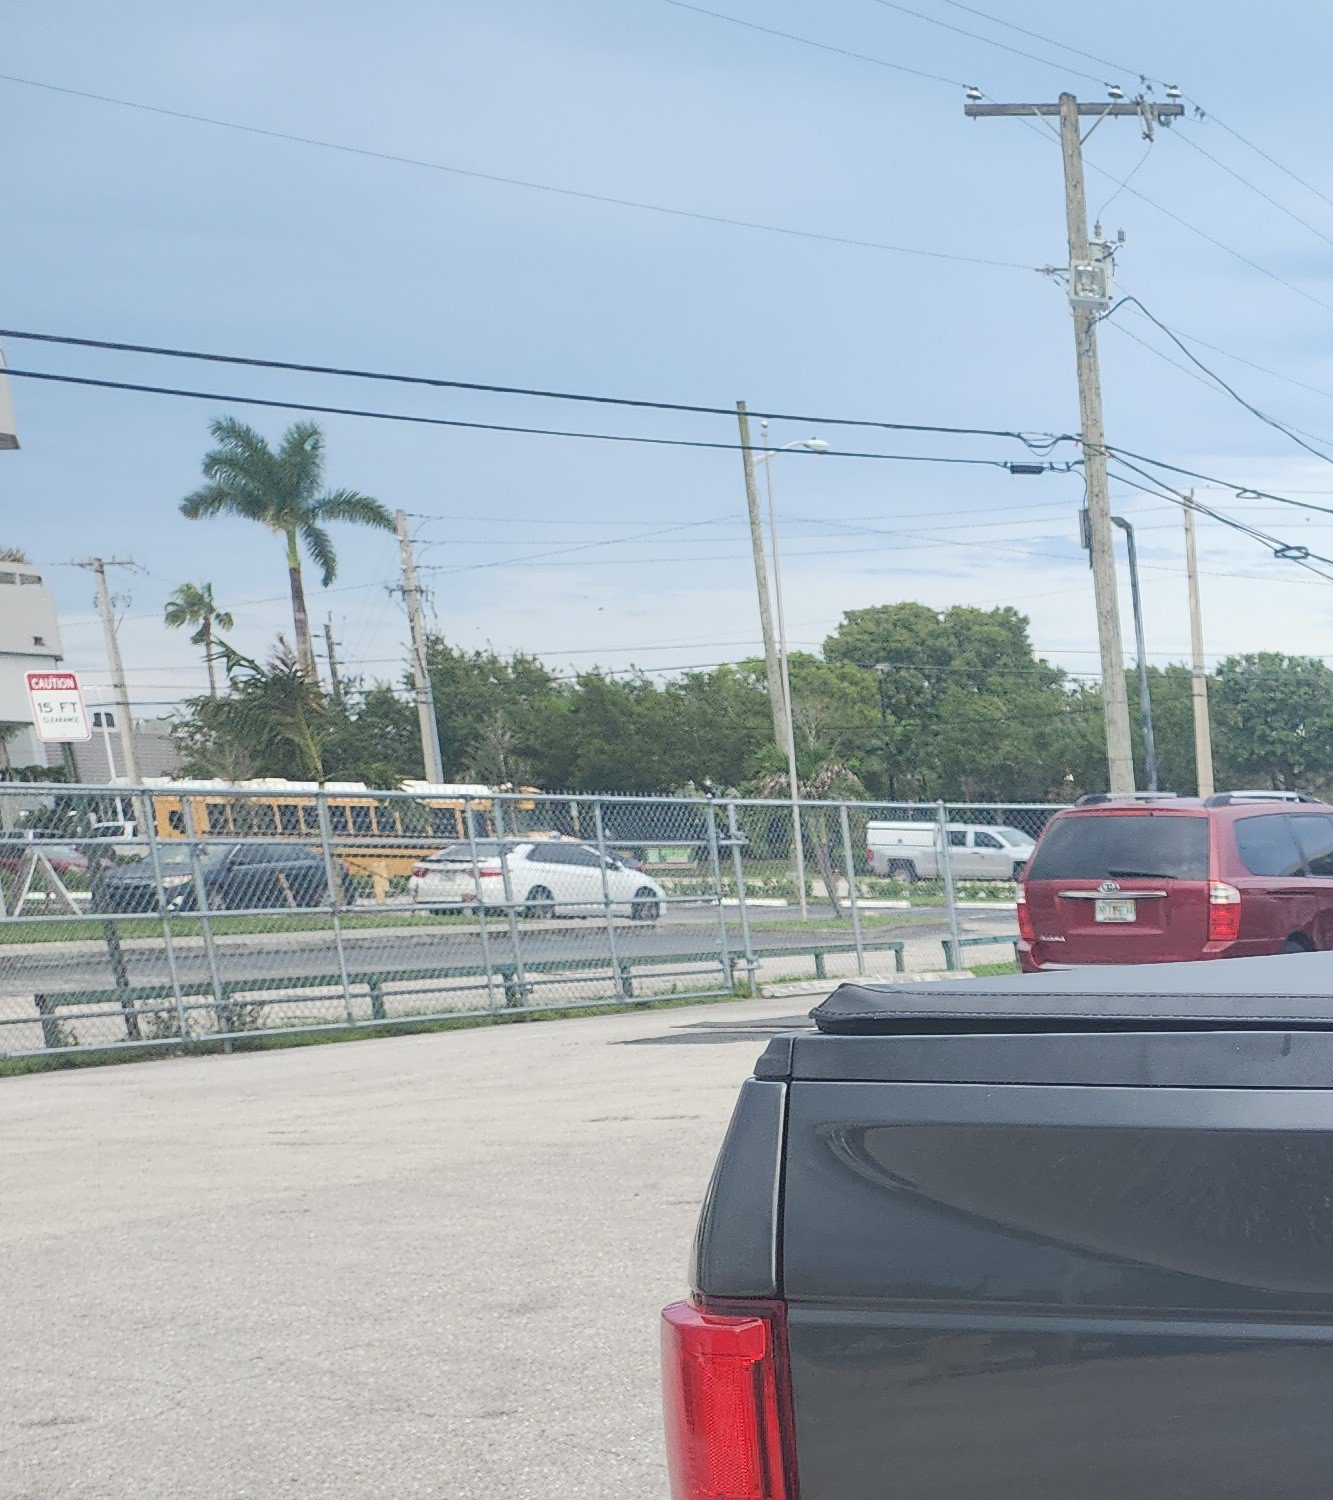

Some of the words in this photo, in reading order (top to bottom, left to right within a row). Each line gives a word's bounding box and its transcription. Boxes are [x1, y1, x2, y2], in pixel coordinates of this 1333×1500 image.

[30, 677, 75, 690] CAUTION
[37, 702, 53, 713] 15
[59, 702, 77, 713] FT
